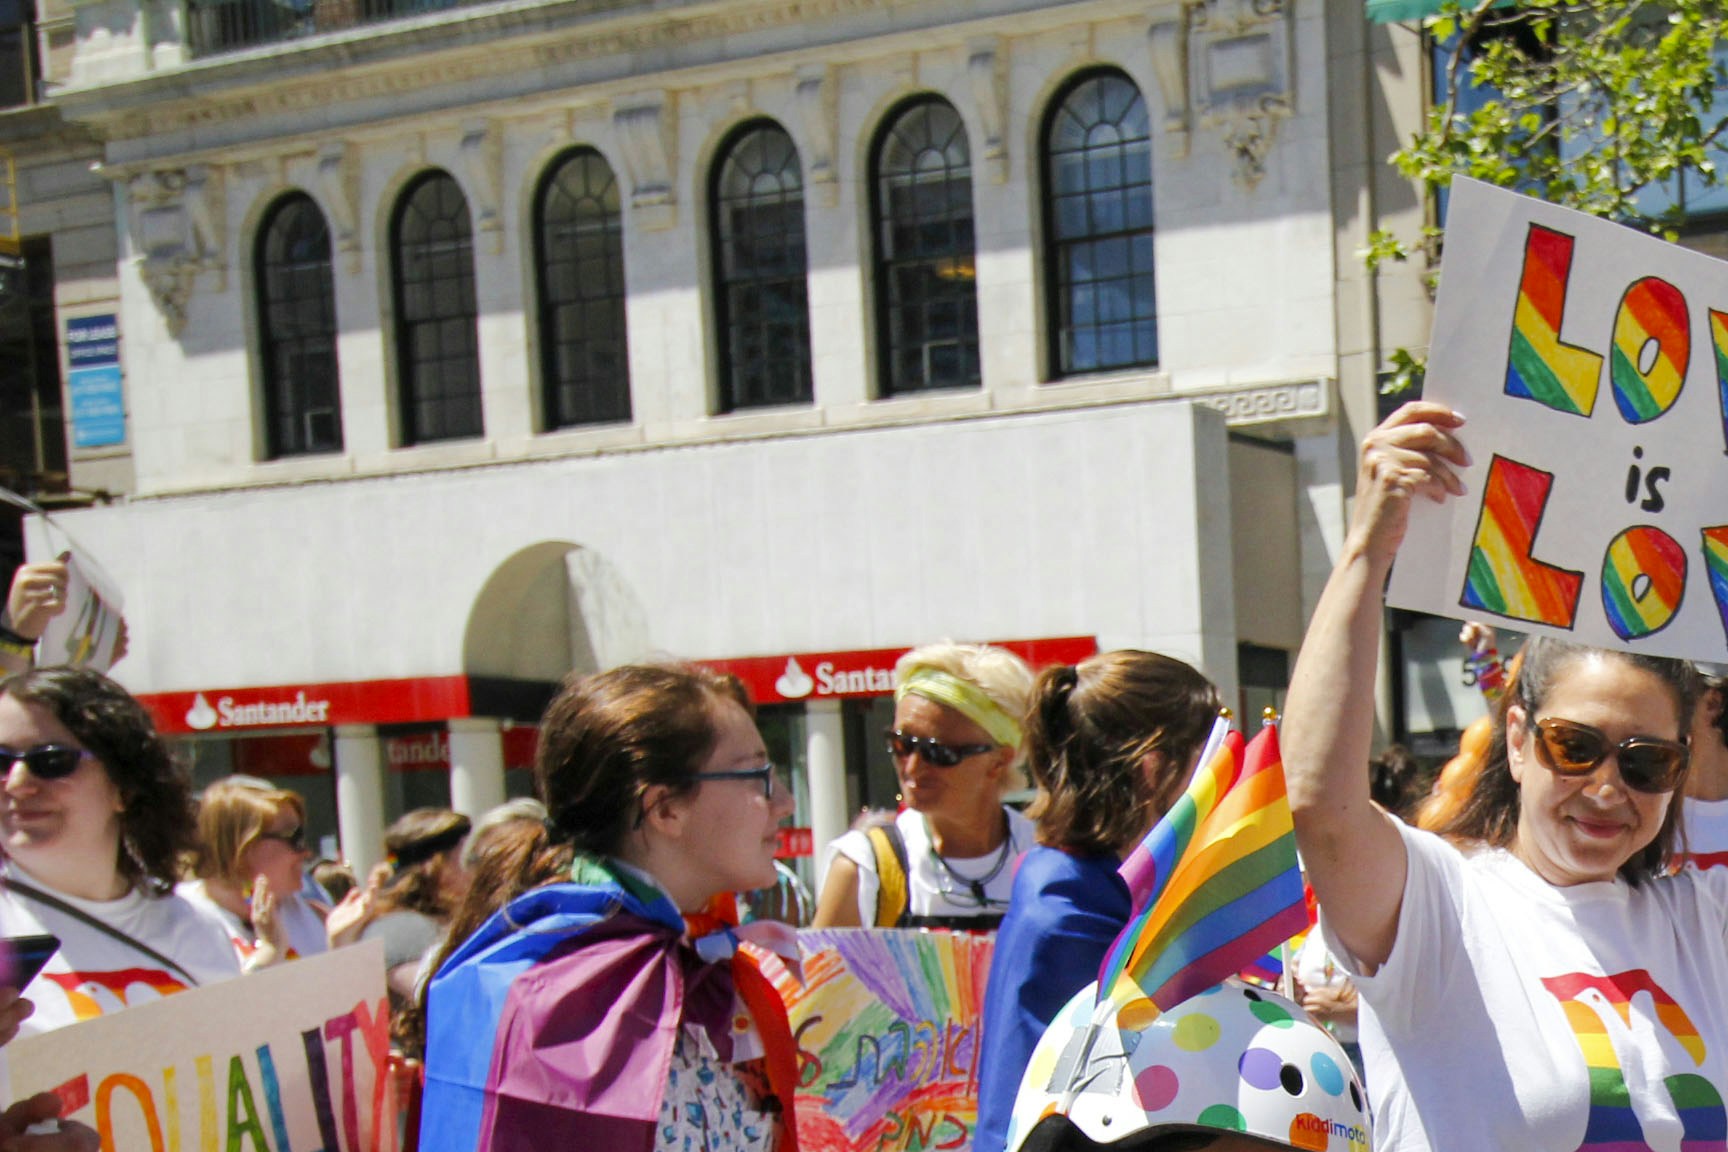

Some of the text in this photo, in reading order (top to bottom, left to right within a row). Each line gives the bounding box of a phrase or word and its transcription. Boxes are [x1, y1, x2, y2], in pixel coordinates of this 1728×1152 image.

[1625, 448, 1671, 513] is
[815, 661, 897, 695] Santa
[217, 690, 330, 727] Santander
